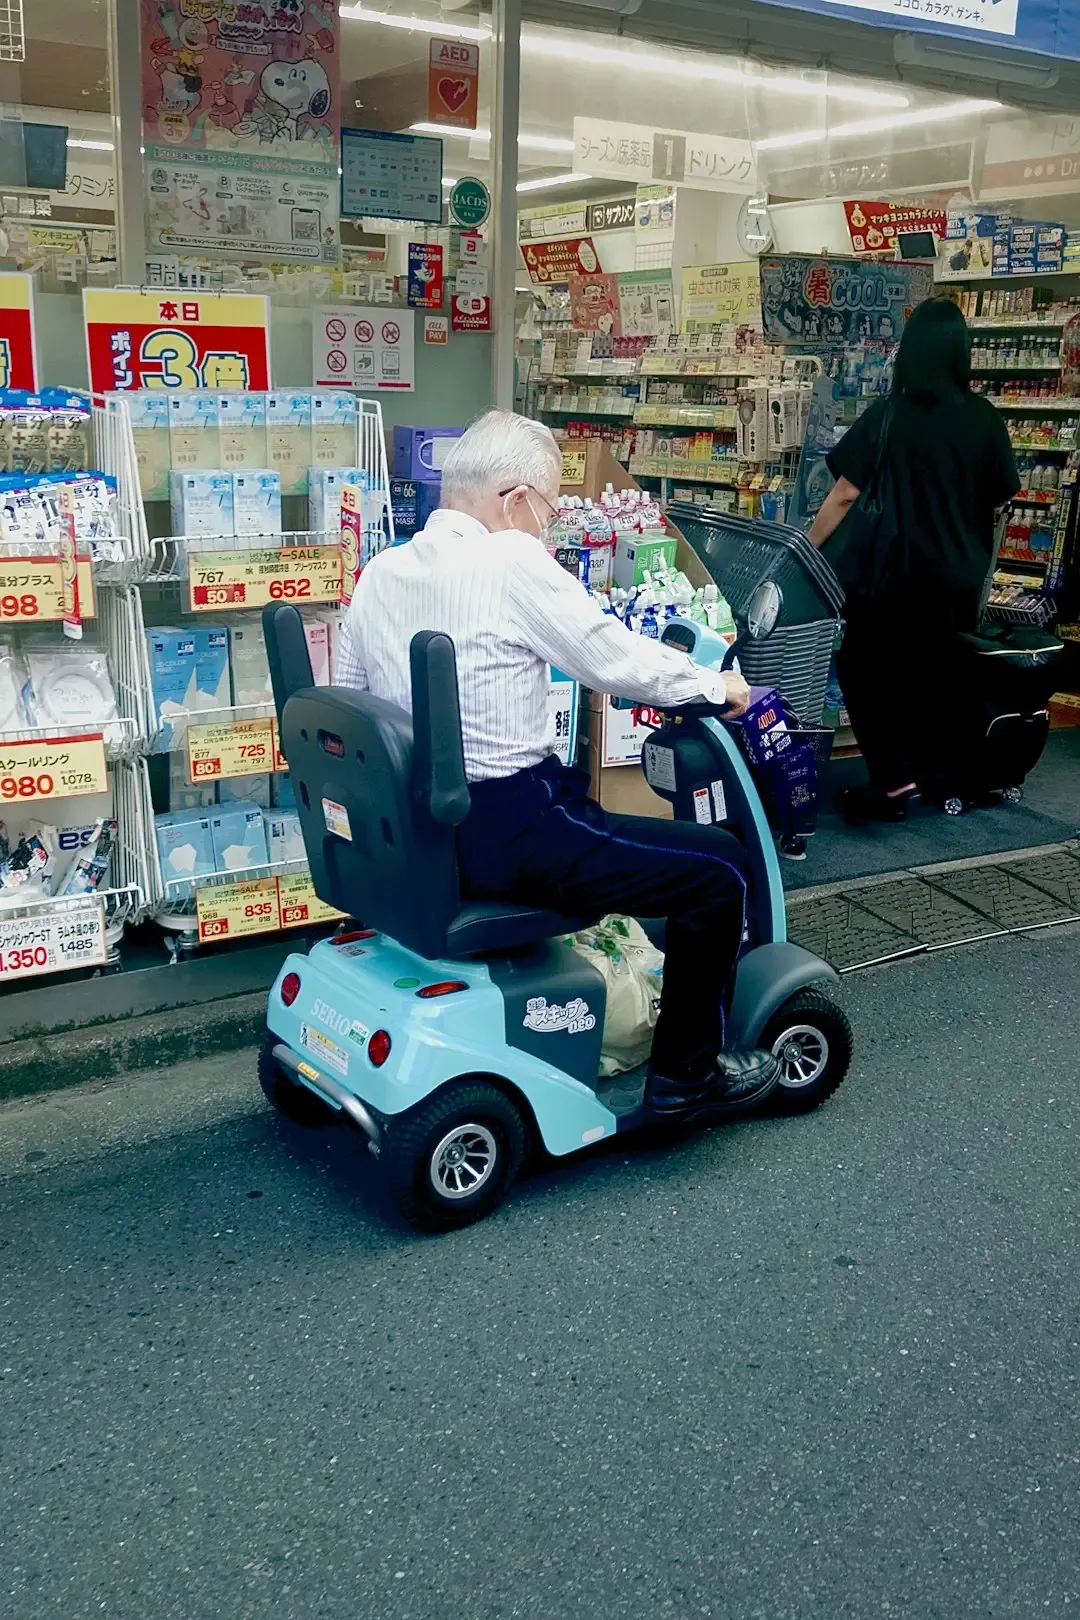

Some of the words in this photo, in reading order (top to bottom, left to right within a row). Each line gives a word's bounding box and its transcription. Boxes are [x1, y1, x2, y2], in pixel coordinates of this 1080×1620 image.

[440, 45, 469, 61] AED
[580, 136, 650, 169] シーズン医薬品
[664, 139, 674, 175] 1
[689, 150, 753, 180] ドリンク
[454, 194, 488, 208] JACDS
[687, 277, 741, 296] 虫さされ対策
[831, 278, 888, 307] COOL
[159, 301, 200, 321] 本日
[429, 331, 442, 339] PAY
[111, 331, 133, 391] ポイン
[263, 549, 320, 562] サマーSALE
[198, 572, 224, 583] 767
[207, 590, 227, 603] 50
[269, 579, 311, 598] 652
[0, 595, 38, 616] 98
[757, 709, 776, 729] 4000
[238, 744, 265, 757] 725
[196, 763, 214, 774] 80
[1, 774, 54, 798] 980
[203, 912, 218, 920] 968
[244, 903, 272, 917] 835
[285, 910, 301, 921] 50
[205, 923, 221, 935] 50
[310, 998, 351, 1037] SERIO
[536, 1000, 582, 1026] スキップ
[569, 1016, 594, 1033] neo
